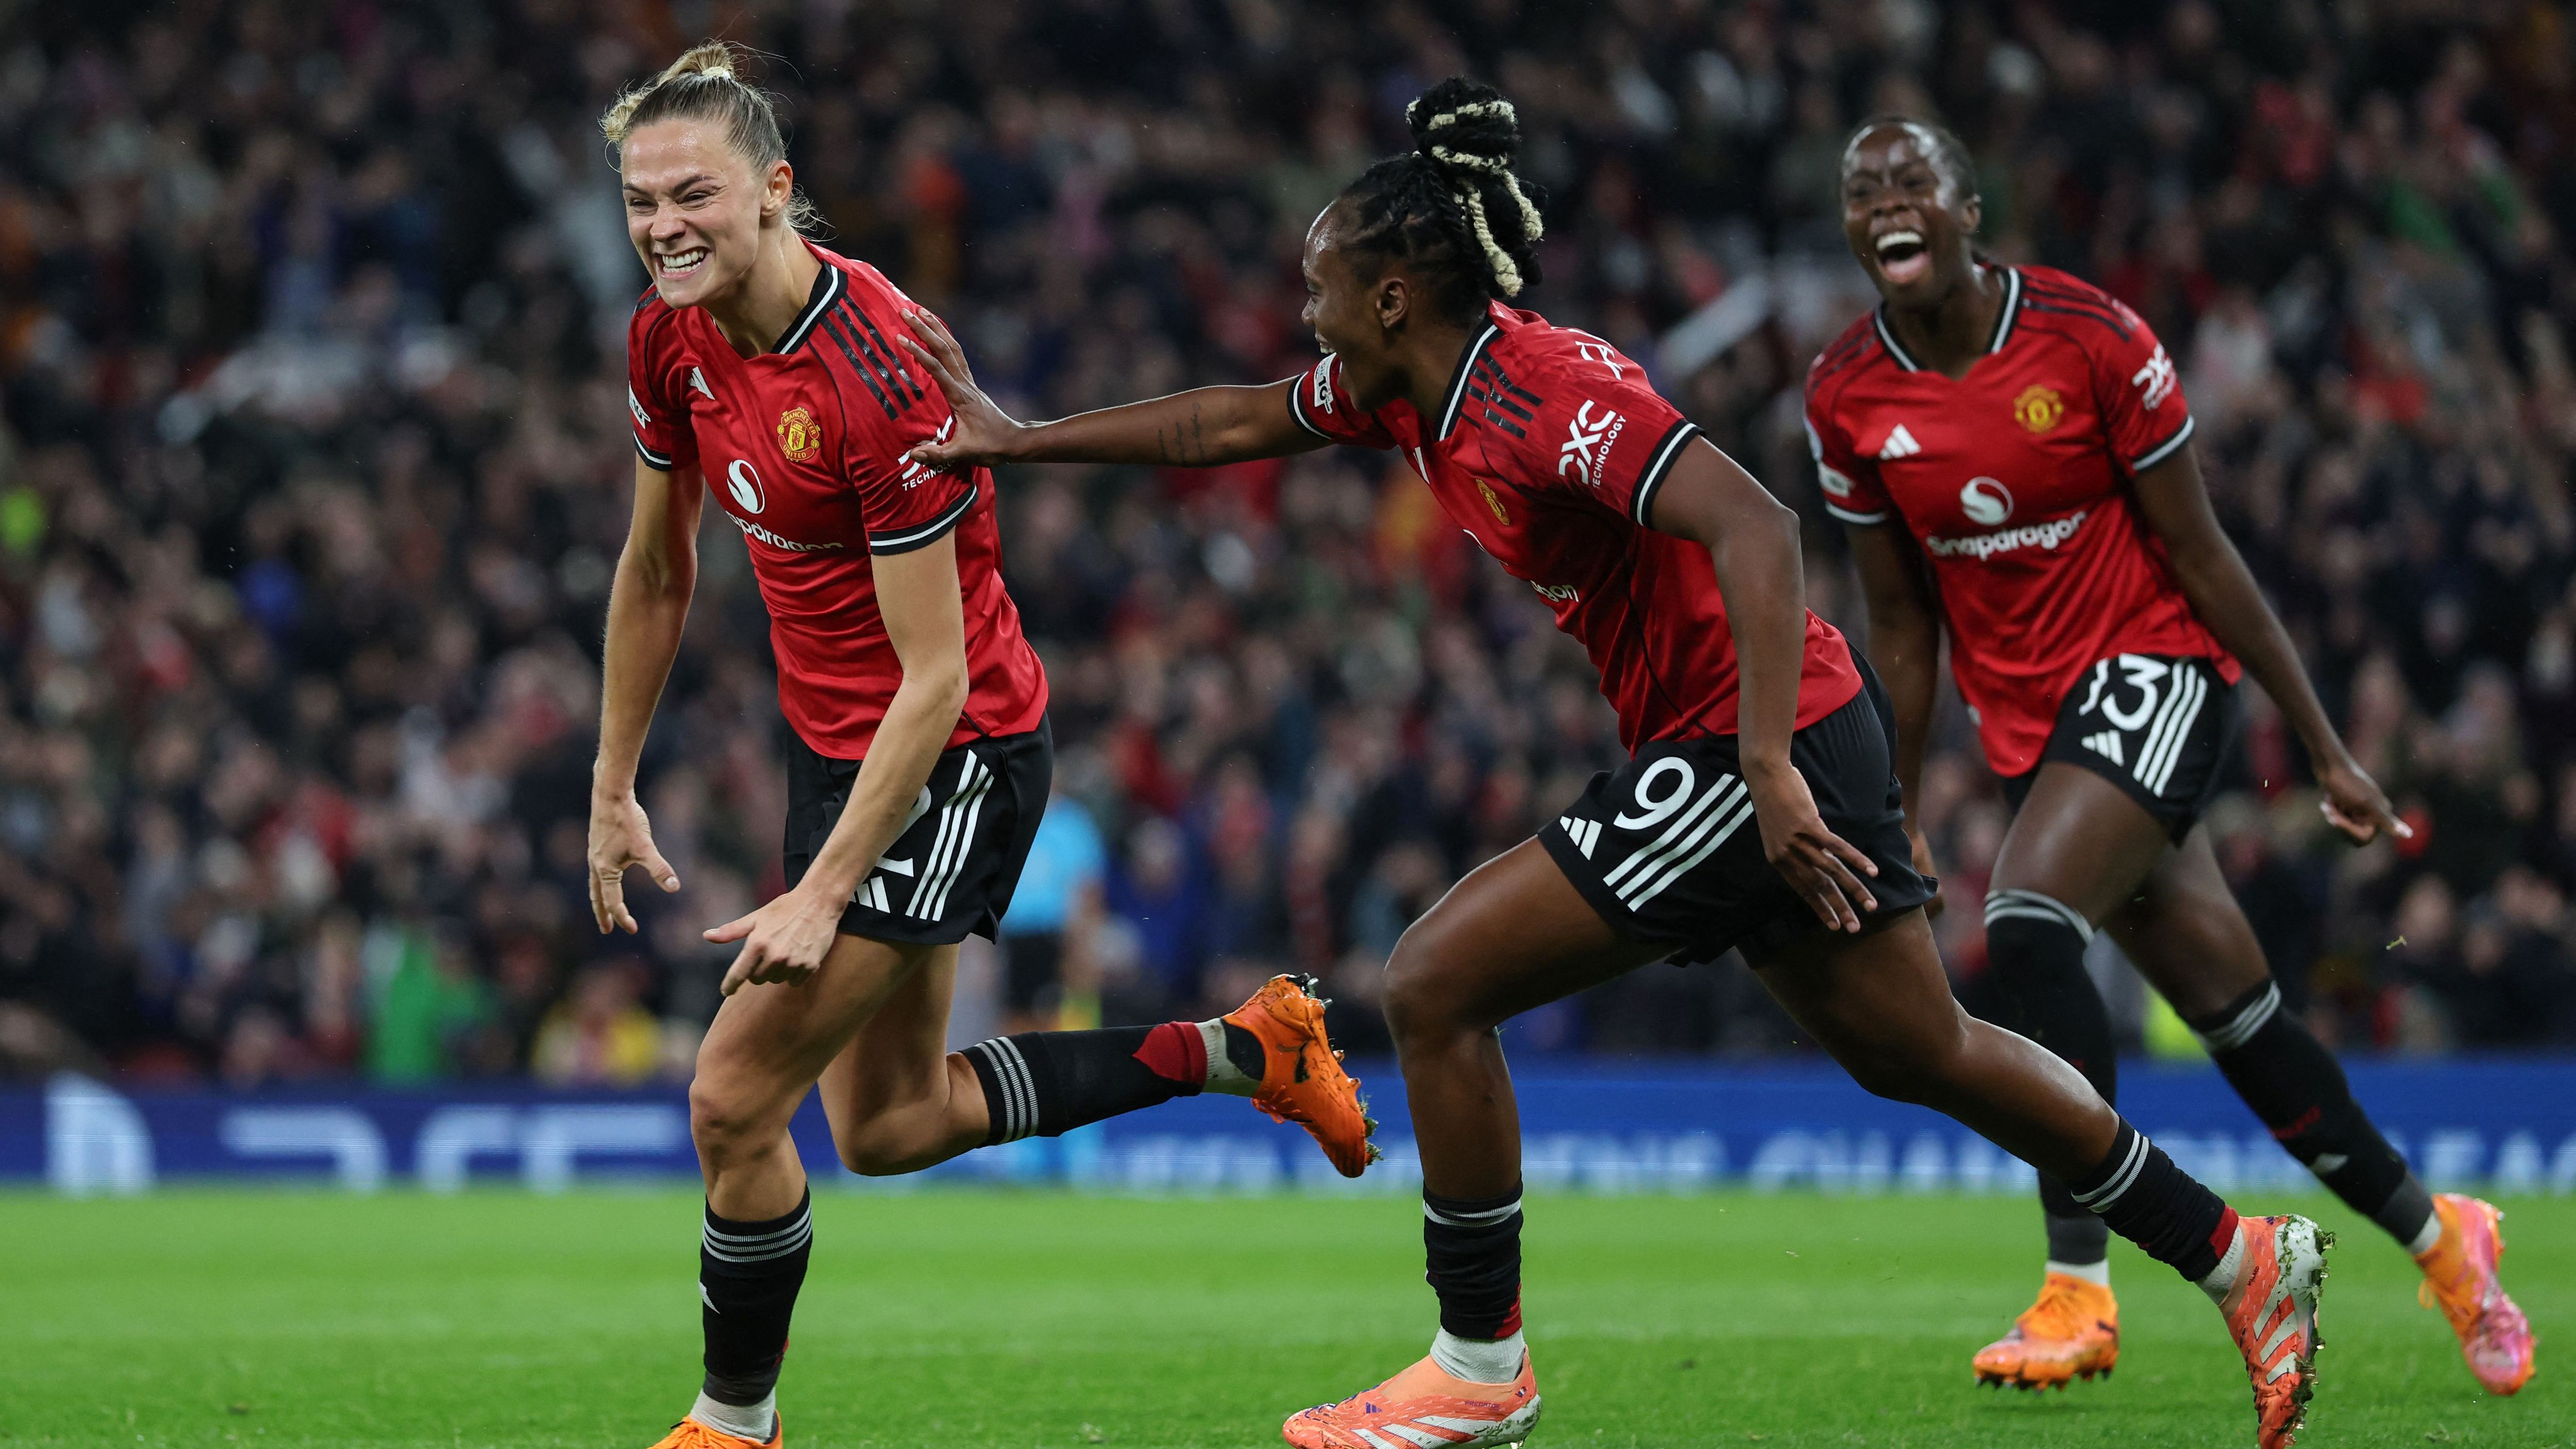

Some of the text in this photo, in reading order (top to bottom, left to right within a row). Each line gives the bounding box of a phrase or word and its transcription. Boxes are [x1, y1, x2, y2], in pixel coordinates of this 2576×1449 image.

[782, 444, 807, 458] UNITED
[784, 411, 816, 435] MANCHESTER
[1558, 399, 1616, 485] DXC
[1593, 415, 1627, 489] TECHNOLOGY
[1613, 756, 1695, 830] 9
